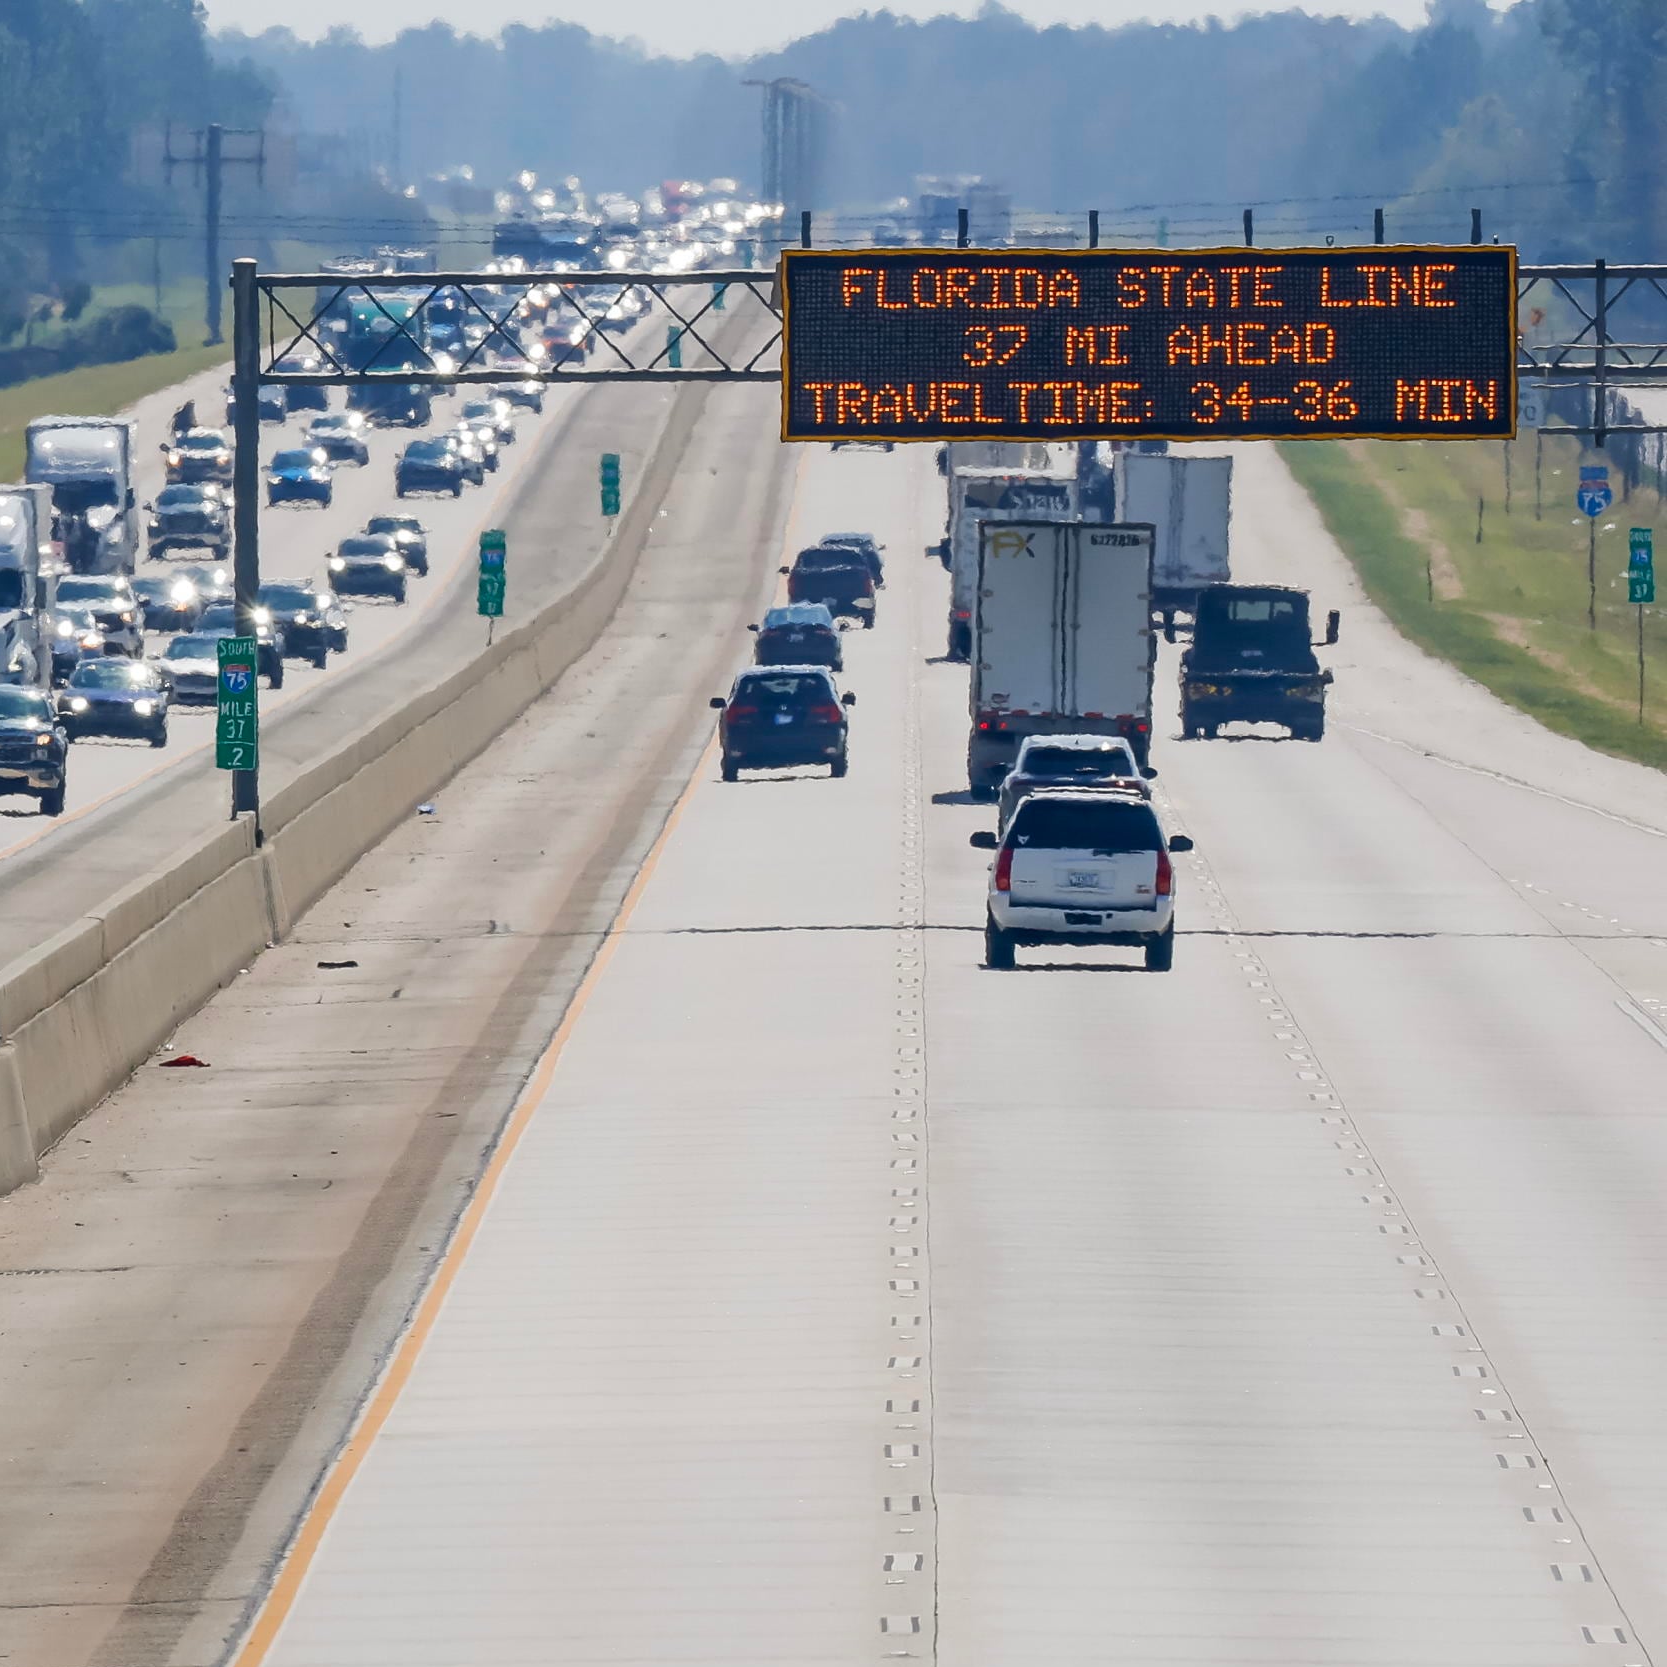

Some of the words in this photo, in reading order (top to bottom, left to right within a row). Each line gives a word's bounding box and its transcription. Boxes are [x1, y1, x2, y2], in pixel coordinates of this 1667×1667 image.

[841, 267, 1079, 310] FLORIDA
[1117, 265, 1284, 308] STATE
[1320, 264, 1456, 308] LINE
[962, 325, 1028, 367] 37
[1065, 324, 1130, 365] MI
[1167, 322, 1336, 366] AHEAD
[803, 381, 1154, 425] TRAVELTIME:
[1190, 380, 1359, 423] 34-36
[1395, 379, 1496, 422] MIN
[1581, 490, 1608, 513] 75
[218, 640, 256, 657] SOUTH
[226, 672, 247, 690] 75
[220, 702, 253, 717] MILE
[226, 719, 245, 739] 37
